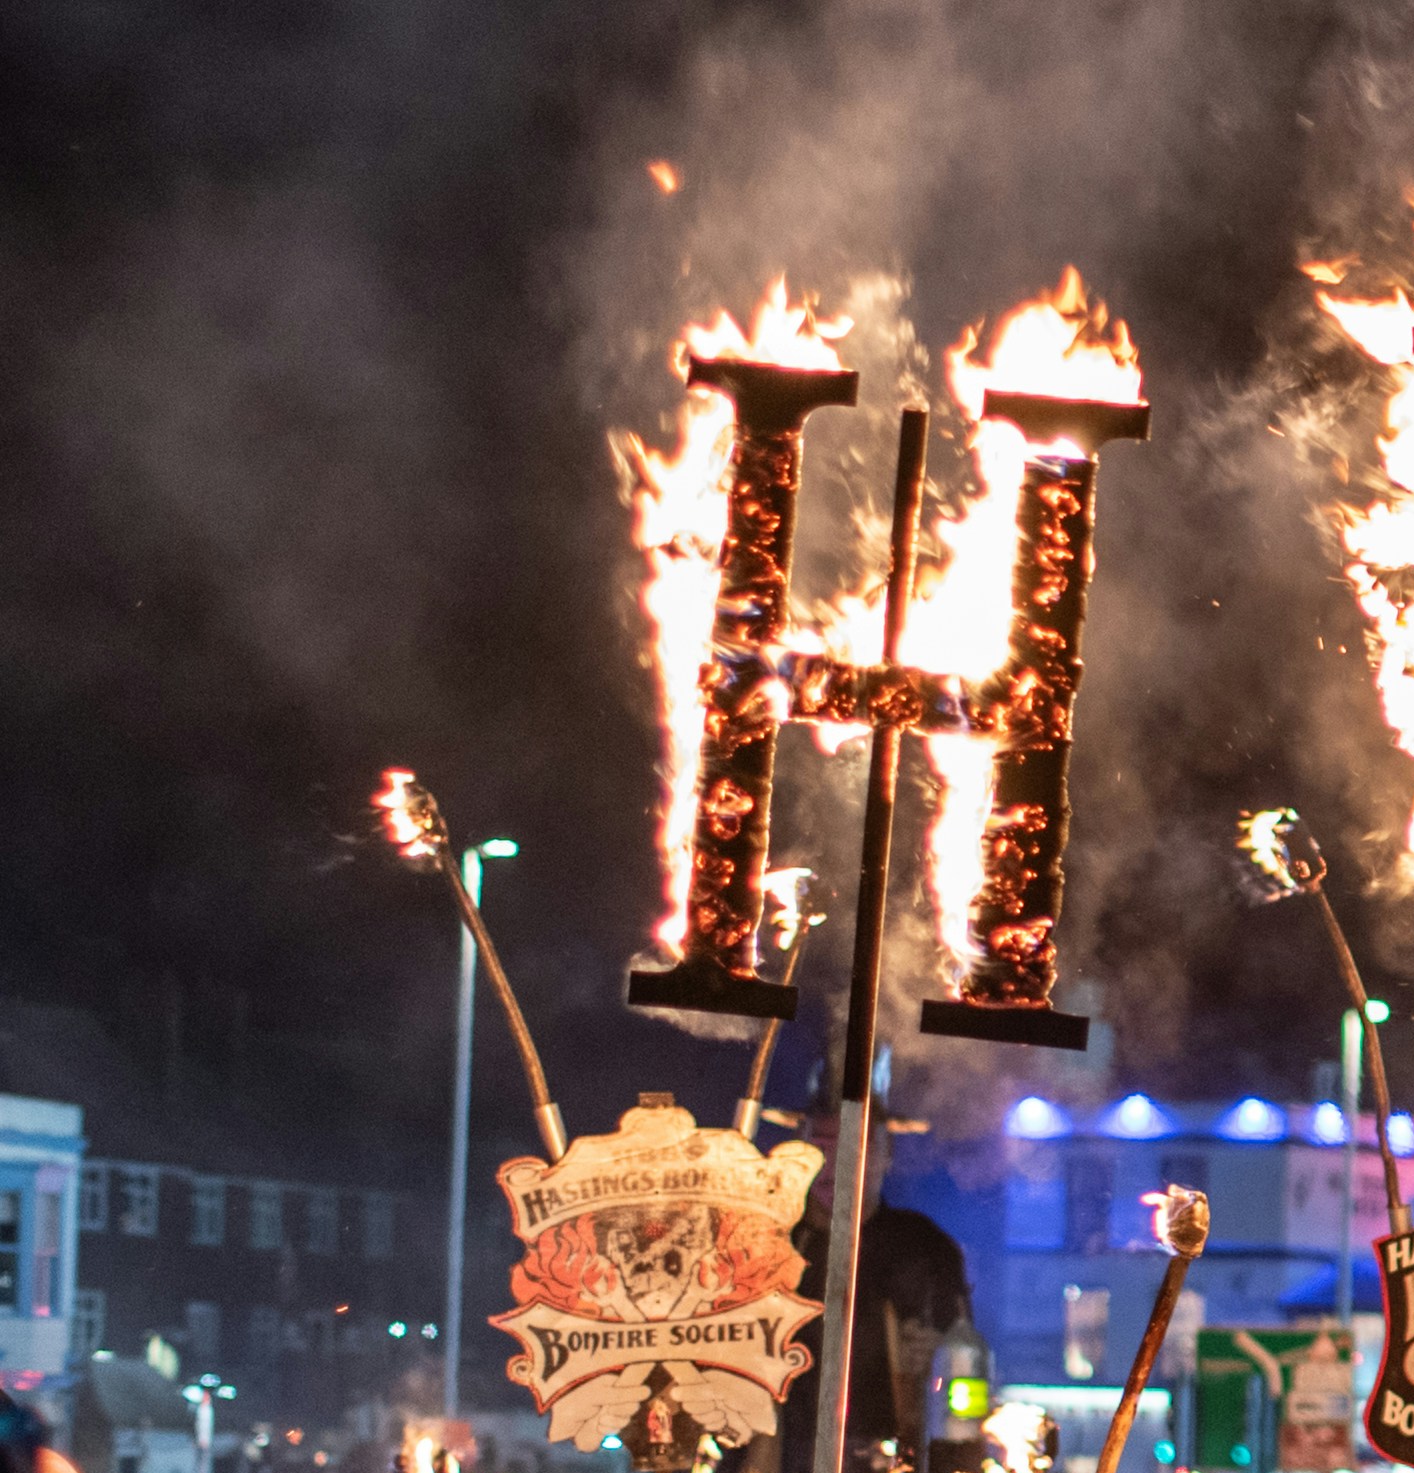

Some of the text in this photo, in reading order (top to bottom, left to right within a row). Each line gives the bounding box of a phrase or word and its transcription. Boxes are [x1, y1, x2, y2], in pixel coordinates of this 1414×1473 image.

[521, 1168, 655, 1228] HASTINGS
[528, 1317, 783, 1382] BONFIRE SOCIETY
